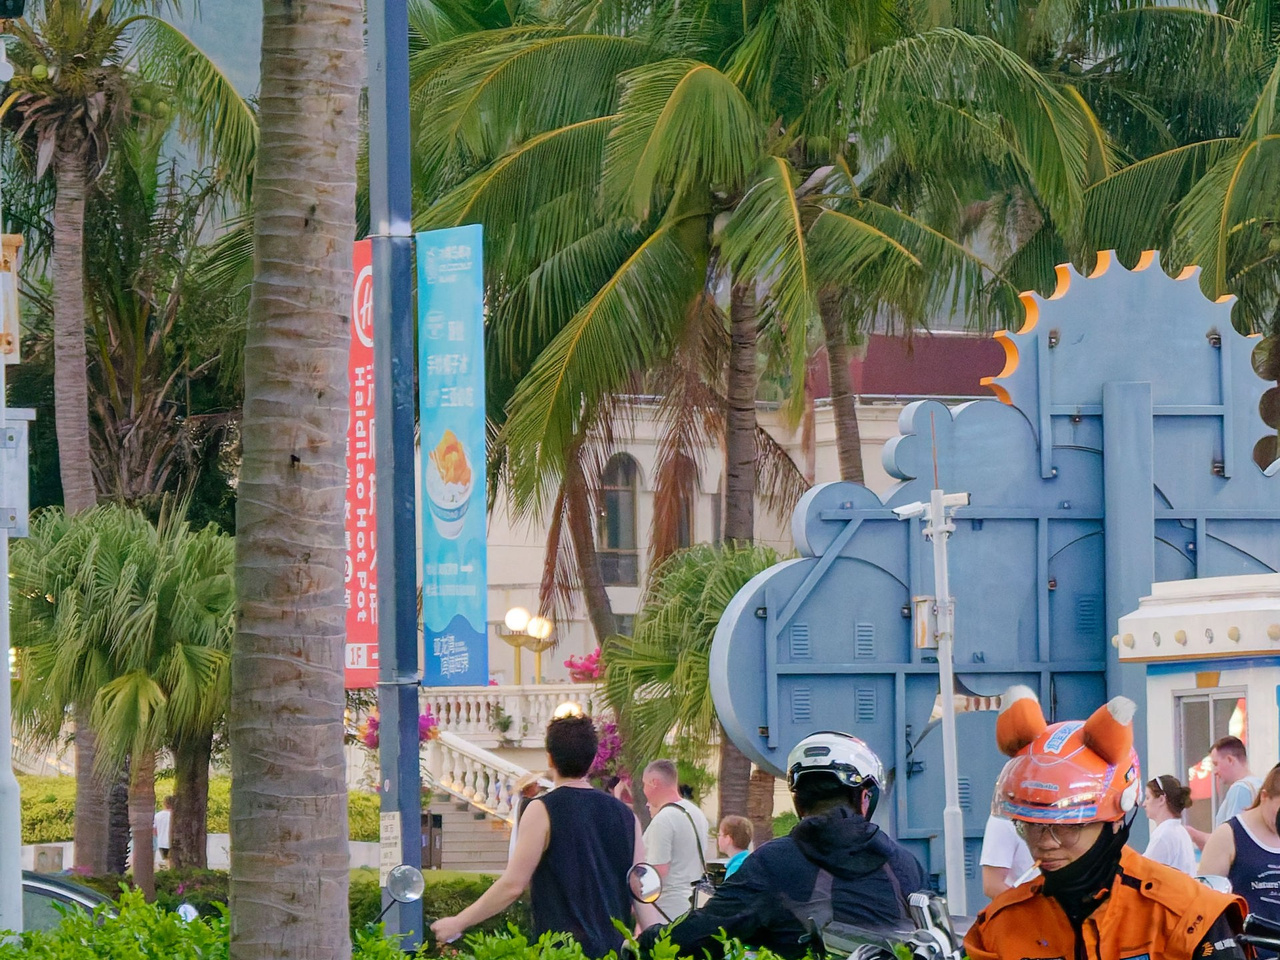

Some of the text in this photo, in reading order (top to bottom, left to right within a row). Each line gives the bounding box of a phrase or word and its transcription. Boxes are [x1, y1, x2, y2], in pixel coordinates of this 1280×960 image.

[354, 366, 367, 622] Haidilao Hot Pot
[350, 646, 362, 665] 1F
